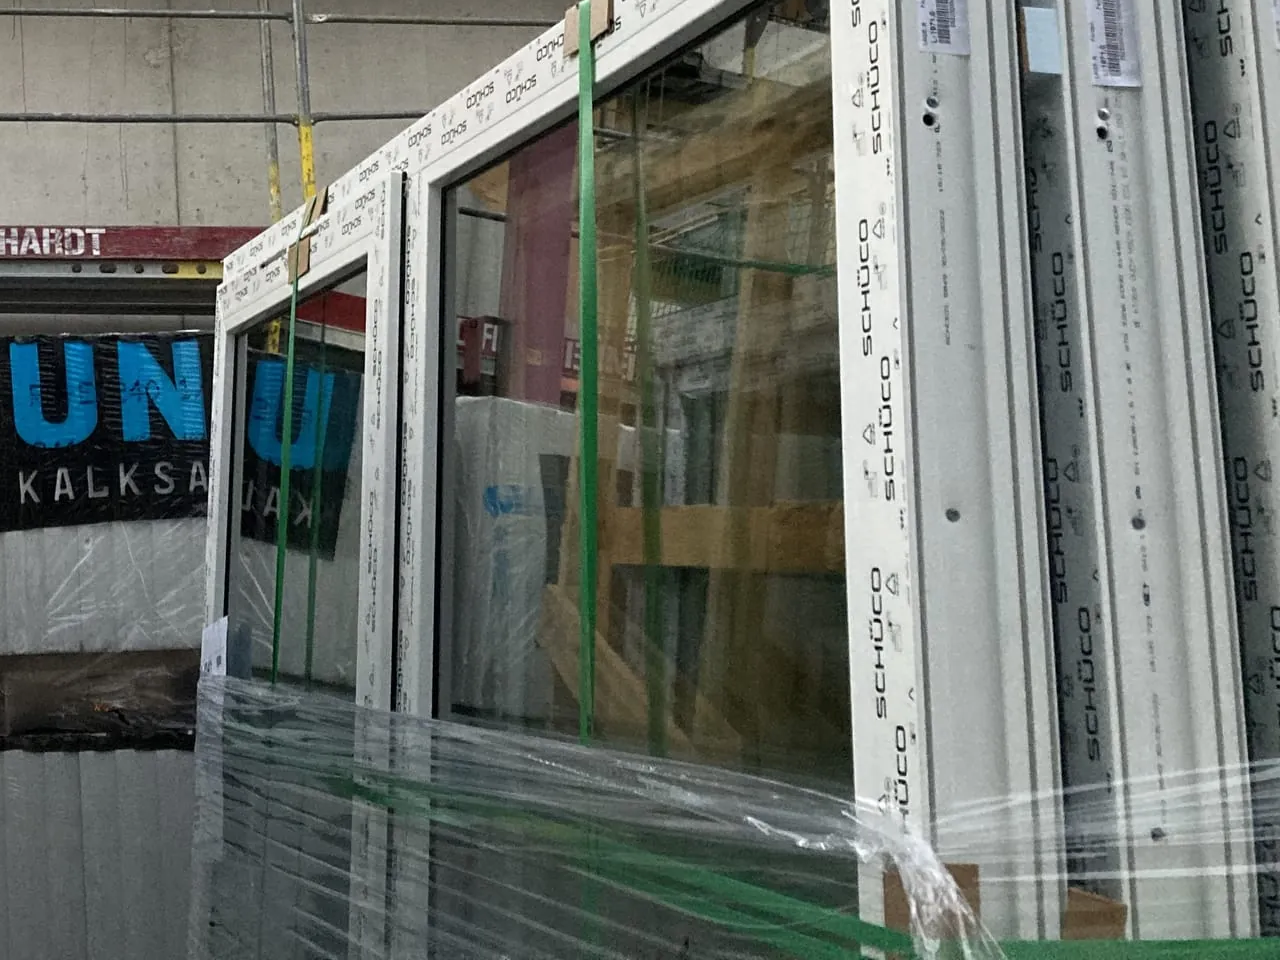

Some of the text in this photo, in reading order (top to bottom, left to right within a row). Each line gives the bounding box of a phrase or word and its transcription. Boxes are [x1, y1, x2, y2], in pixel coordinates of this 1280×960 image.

[866, 20, 882, 155] SCHÜCO
[856, 218, 872, 357] SCHÜCO
[1050, 250, 1073, 394] SCHÜCO
[1239, 250, 1266, 393] SCHÜCO
[878, 355, 896, 502] SCHÜCO
[869, 567, 888, 720] SCHÜCO
[1076, 606, 1101, 762] SCHÜCO
